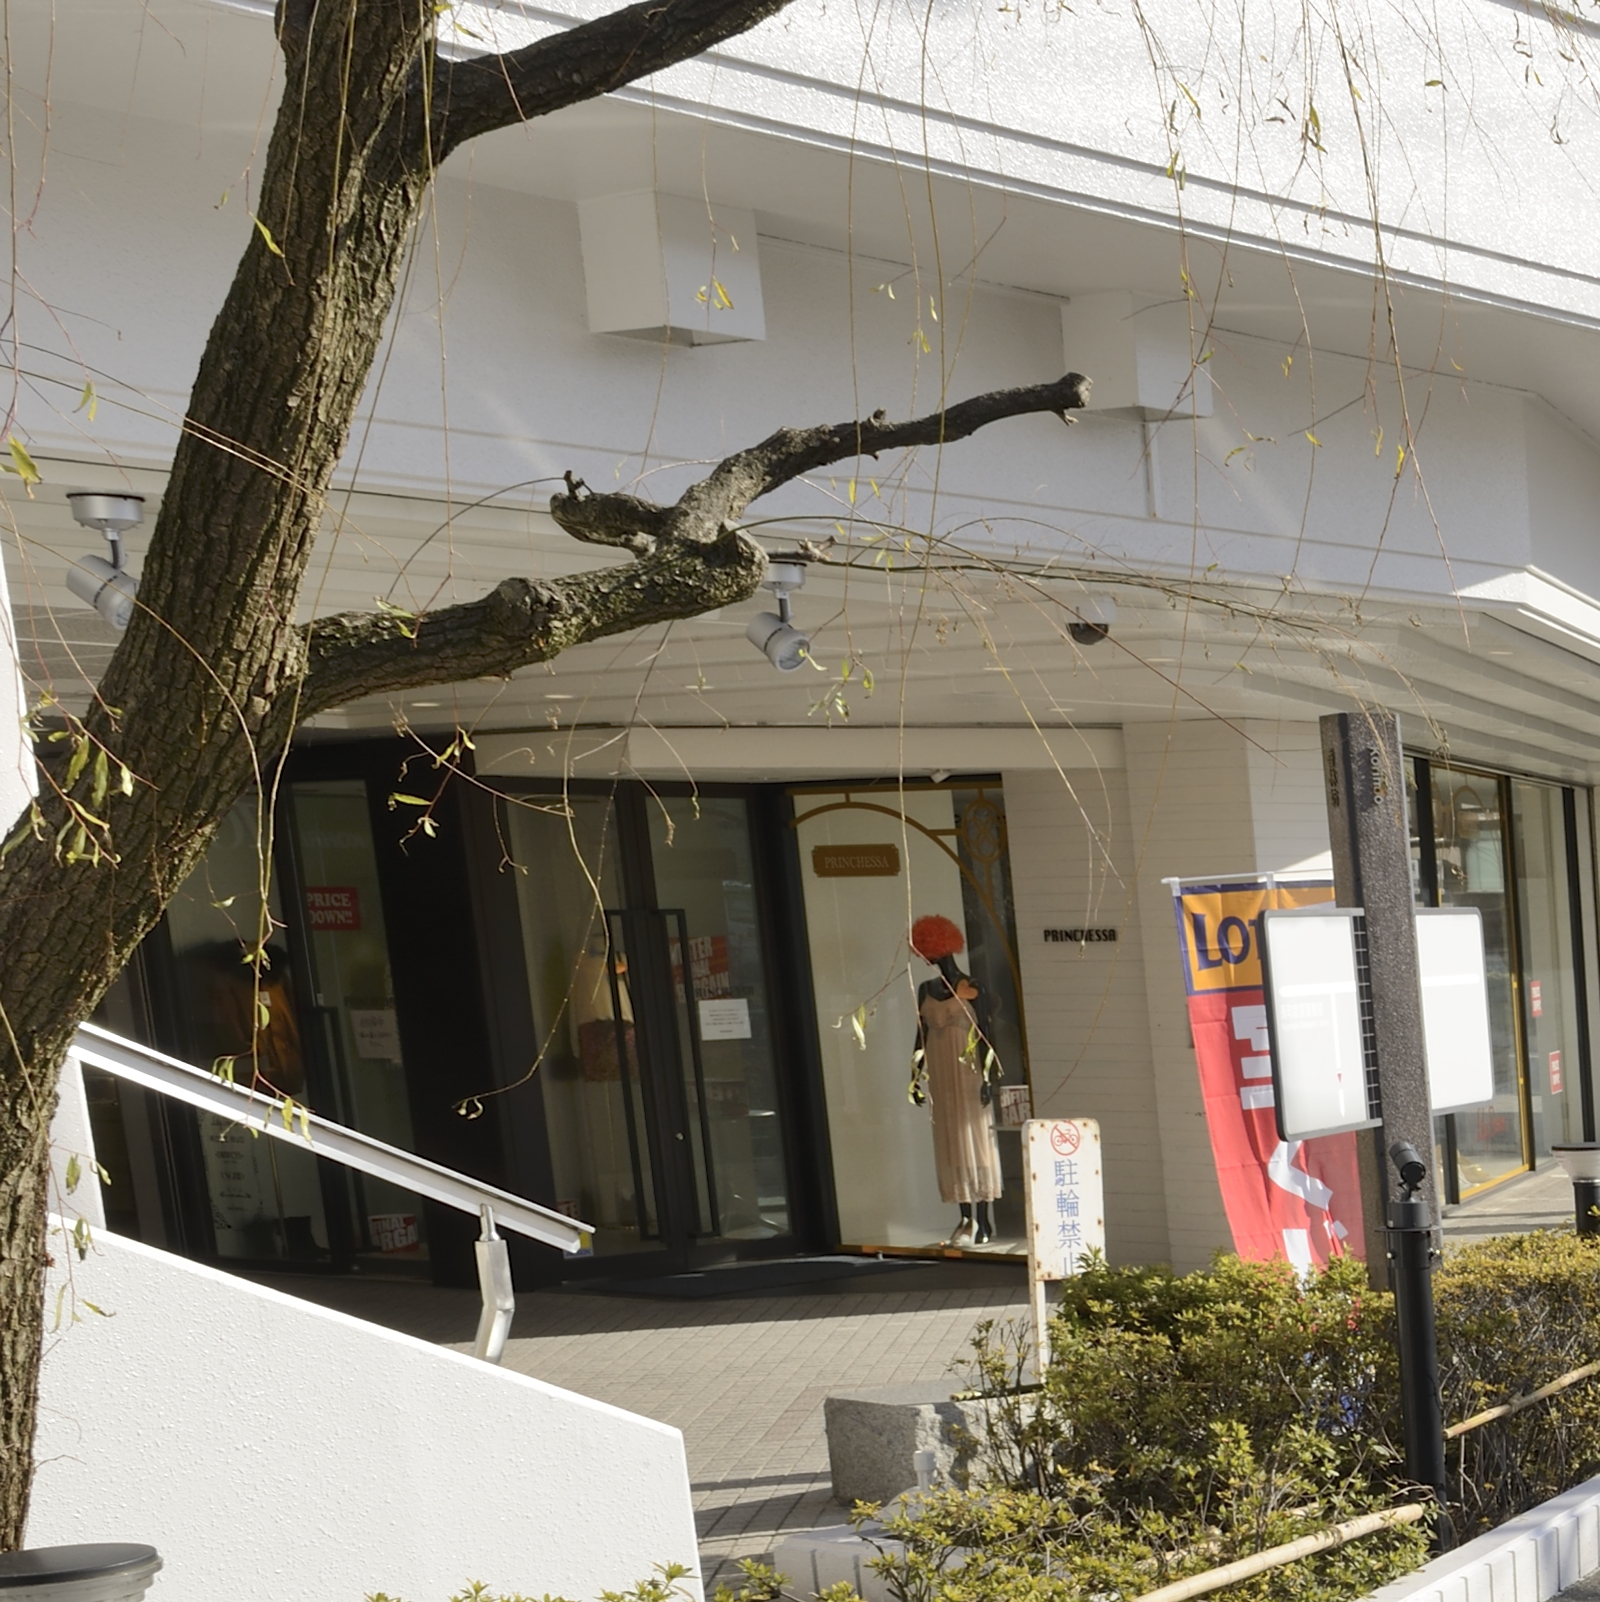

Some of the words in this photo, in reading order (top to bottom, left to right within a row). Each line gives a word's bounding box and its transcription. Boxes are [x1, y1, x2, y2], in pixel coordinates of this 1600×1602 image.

[824, 855, 889, 869] PRINCHESSA
[306, 892, 352, 907] PRICE
[1043, 929, 1117, 943] PRINCHESSA
[1192, 911, 1262, 971] LO
[1054, 1158, 1082, 1278] 駐輪禁止
